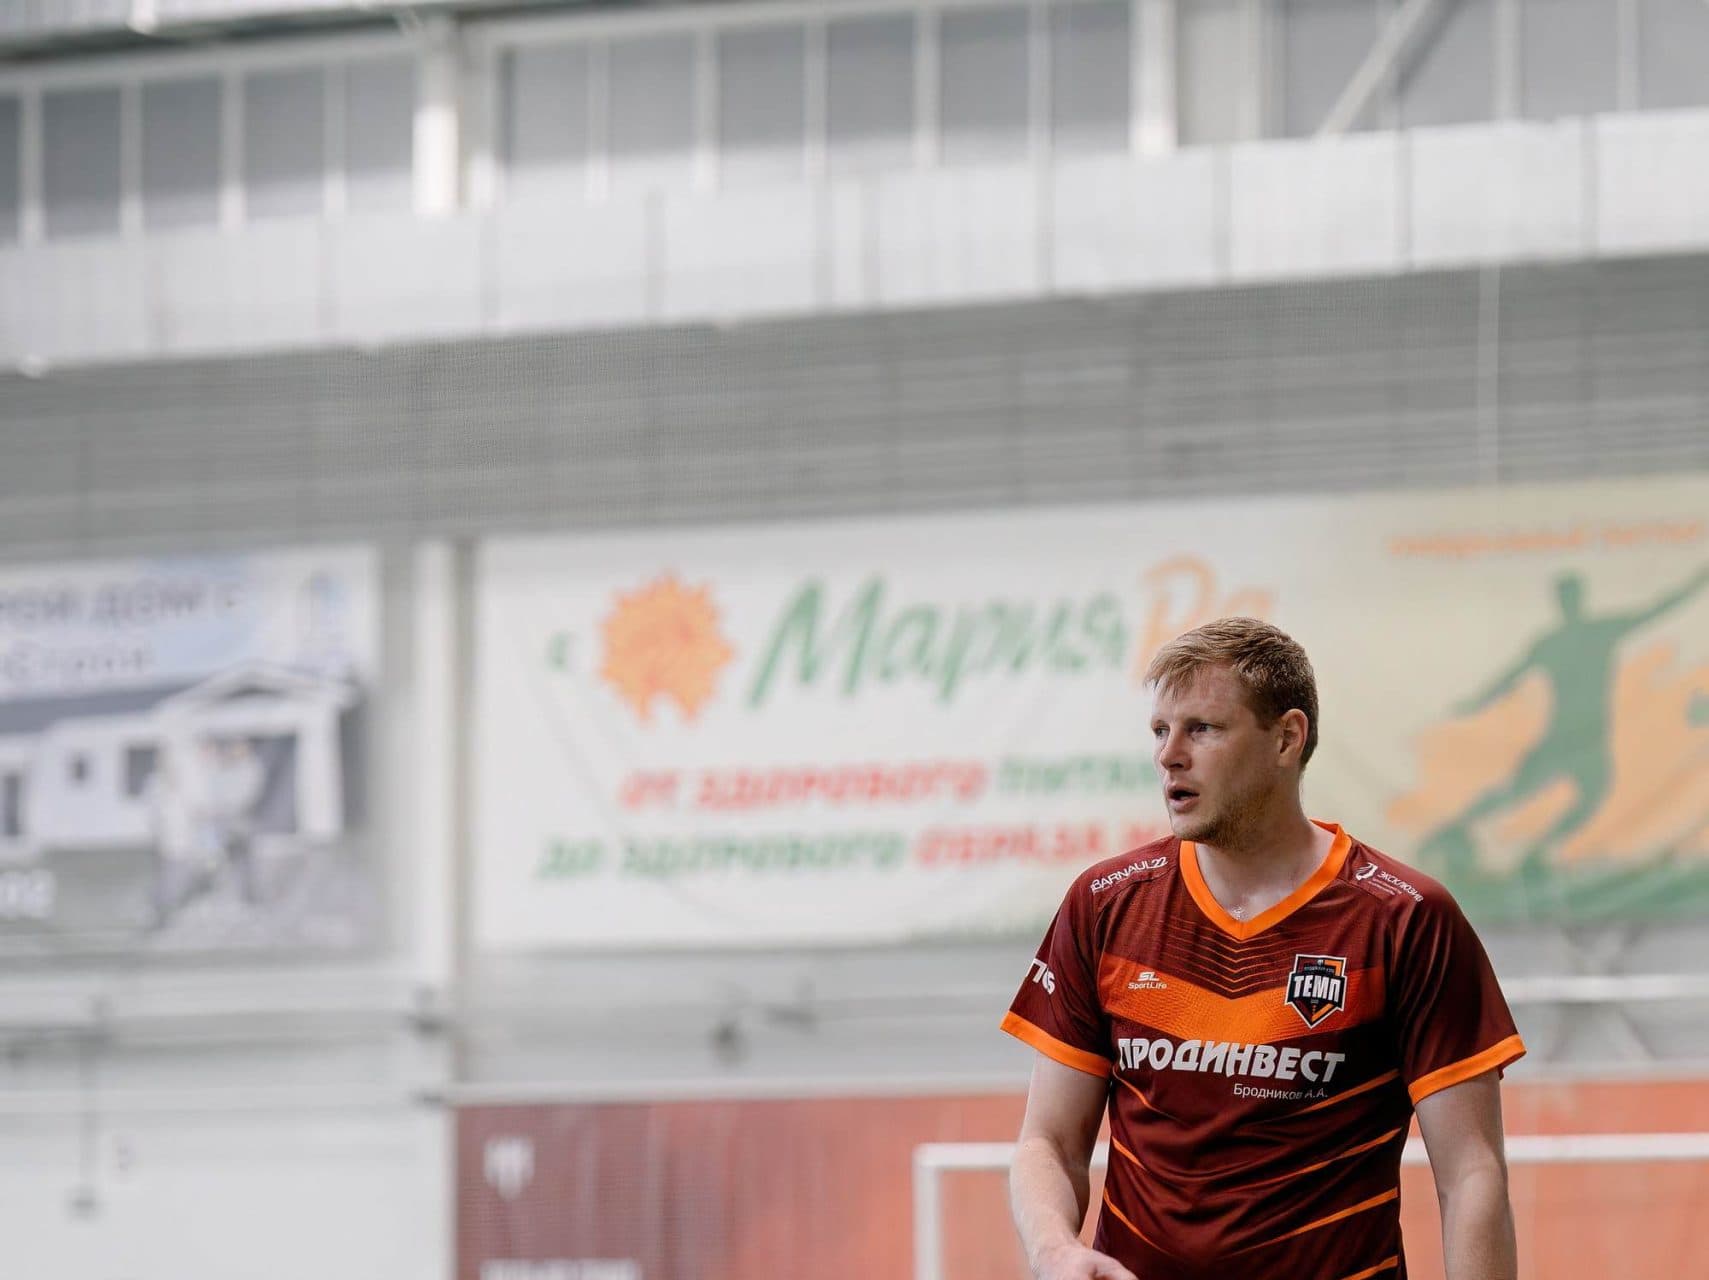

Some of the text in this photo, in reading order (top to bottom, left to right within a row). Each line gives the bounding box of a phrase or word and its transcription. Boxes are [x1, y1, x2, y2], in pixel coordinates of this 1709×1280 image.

[1293, 974, 1341, 1003] ТЕМП
[1117, 1038, 1346, 1083] ПРОДИНВЕСТ
[1233, 1083, 1303, 1100] Бродников
